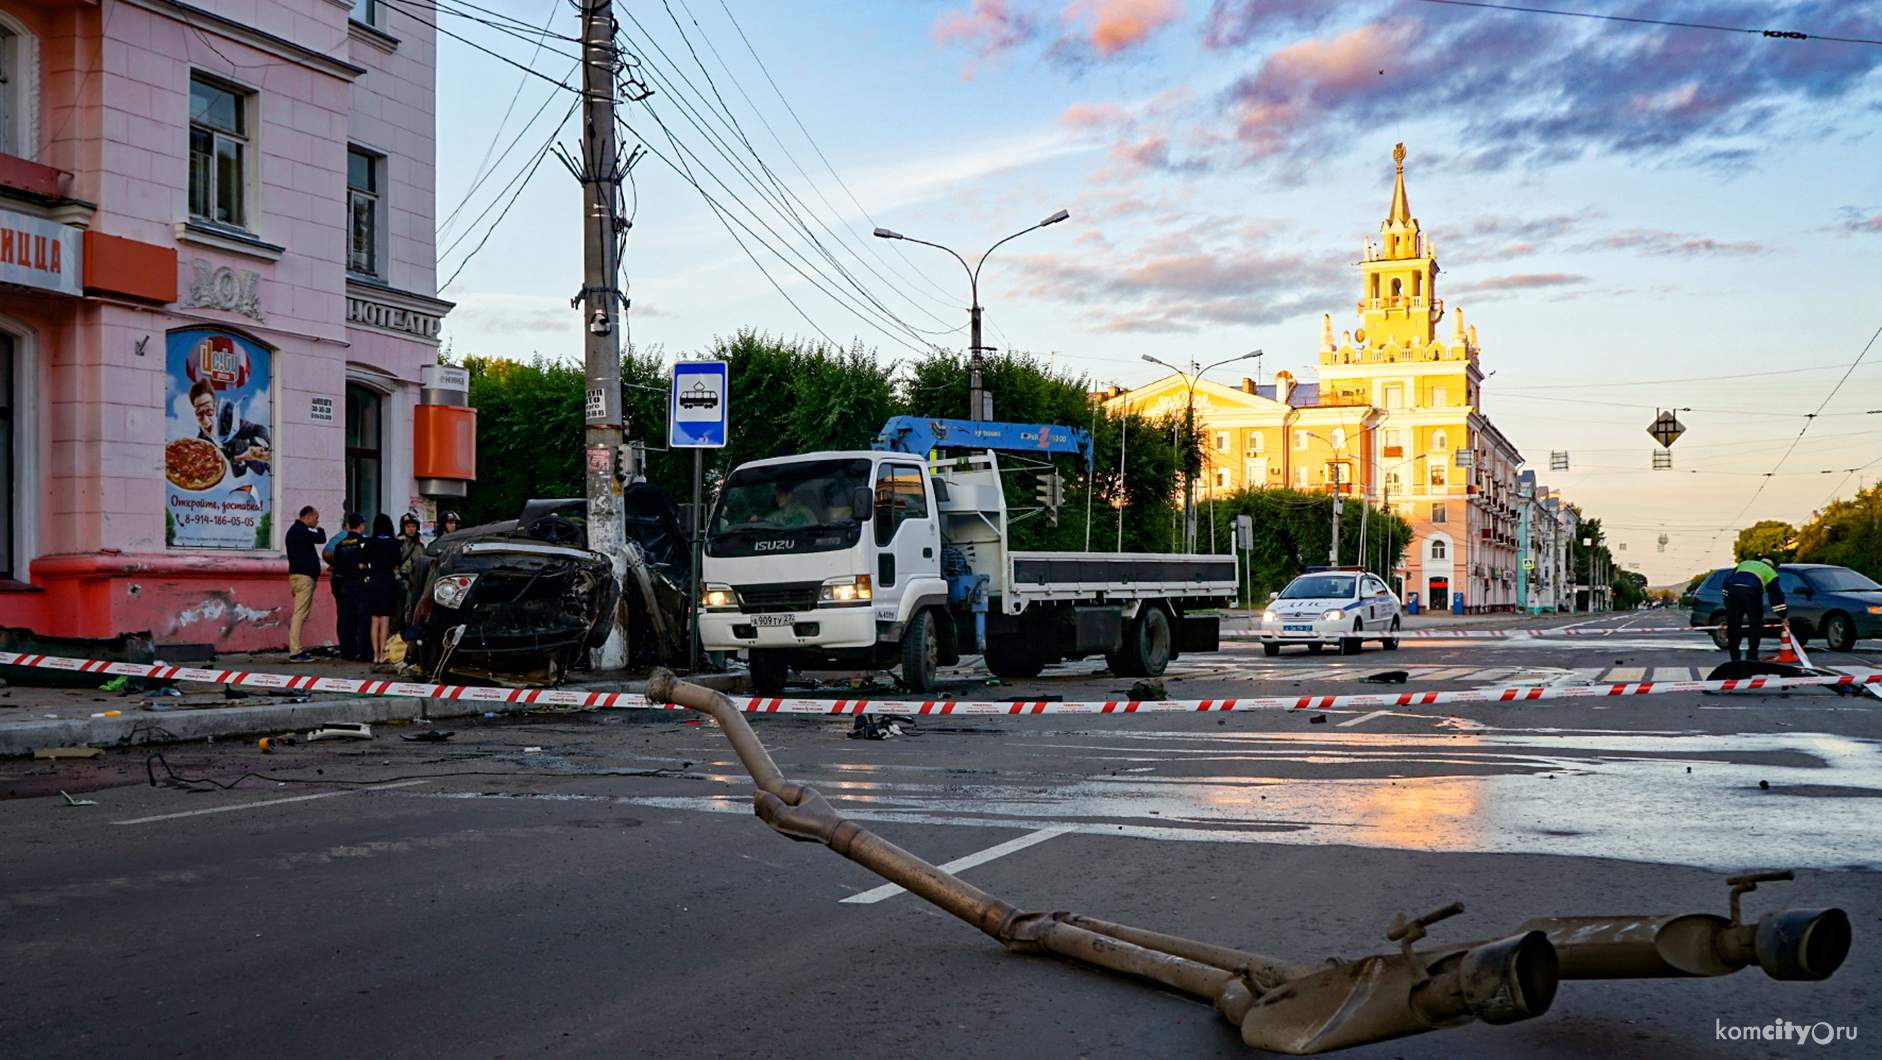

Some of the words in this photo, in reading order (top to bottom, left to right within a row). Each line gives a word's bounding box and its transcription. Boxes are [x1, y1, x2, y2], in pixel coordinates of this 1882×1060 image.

[0, 227, 62, 274] ИЦЦА
[347, 298, 442, 338] НОТЕАТР
[170, 494, 220, 512] Откройте,
[221, 499, 264, 514] доставка!
[184, 513, 255, 527] 8-914-186-05-05
[754, 540, 795, 551] ISUZU
